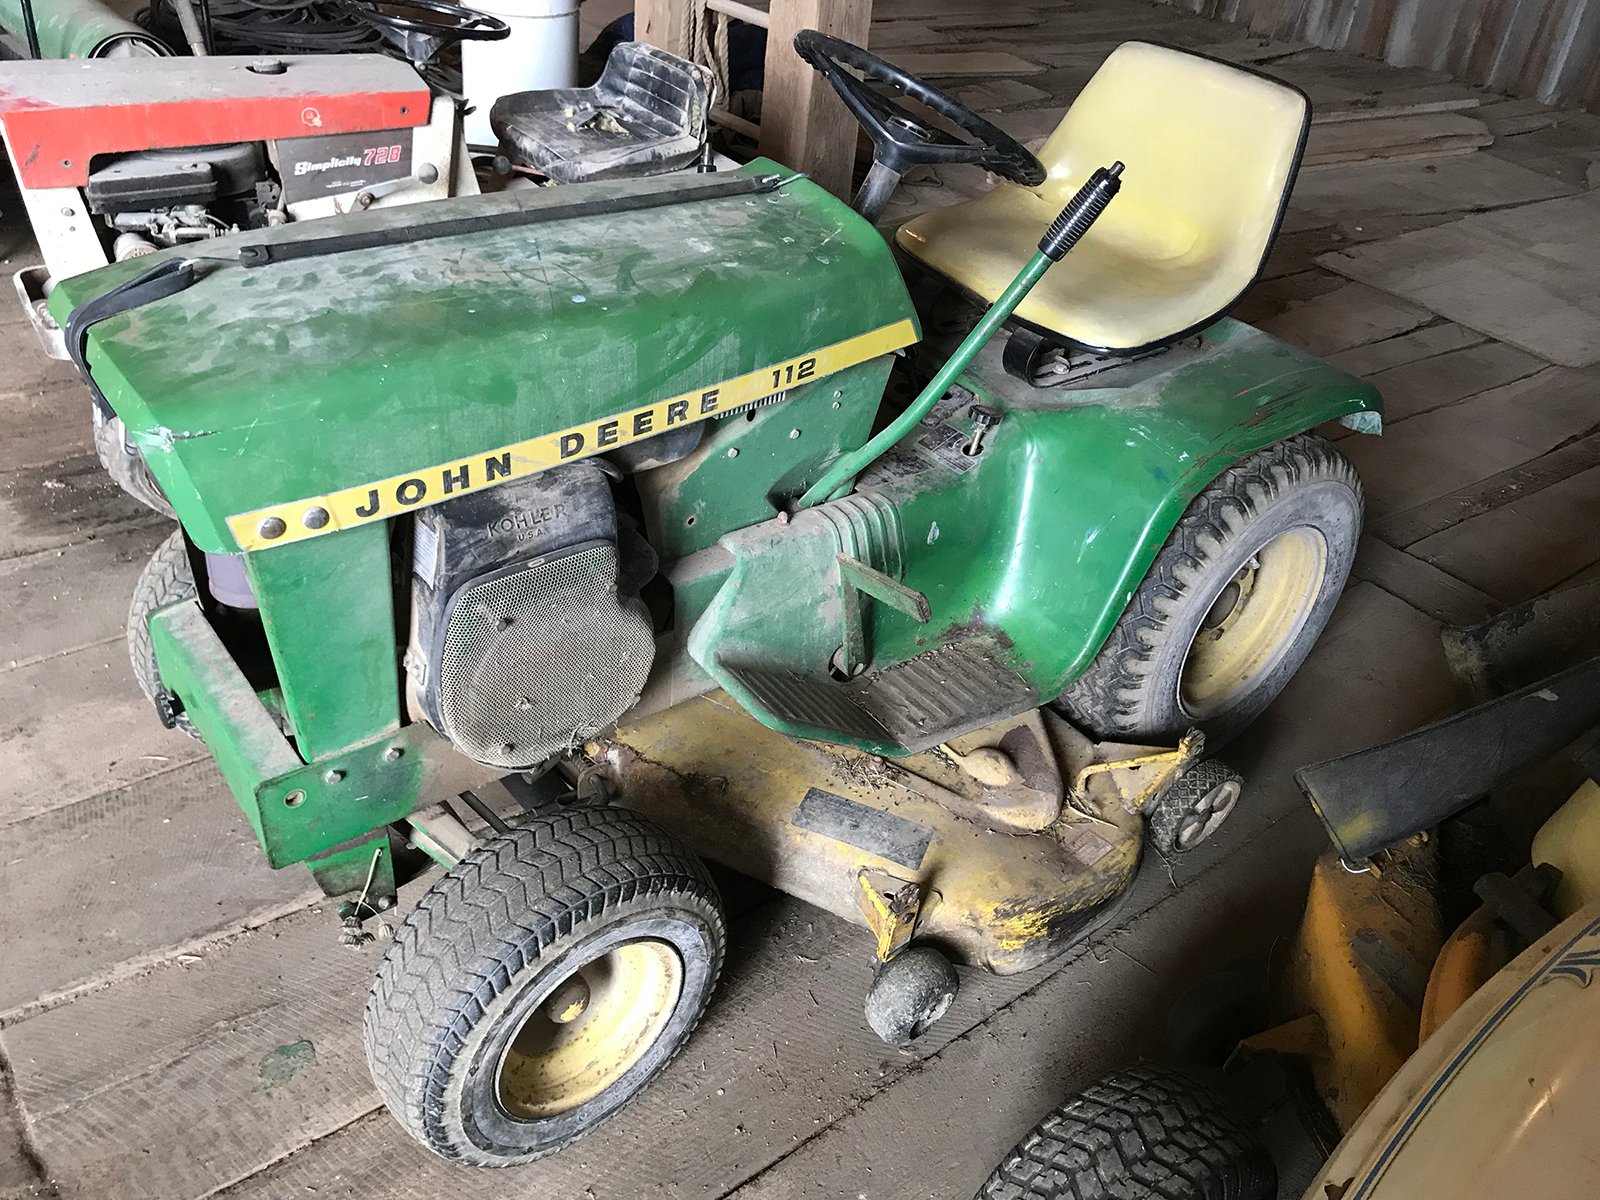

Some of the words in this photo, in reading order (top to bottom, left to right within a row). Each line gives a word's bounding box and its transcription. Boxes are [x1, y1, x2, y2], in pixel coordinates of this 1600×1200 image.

[294, 155, 362, 176] Simplicity
[363, 145, 402, 167] 728
[355, 452, 512, 518] JOHN
[560, 389, 720, 459] DEERE
[772, 357, 817, 389] 112
[487, 504, 568, 537] KOHLER
